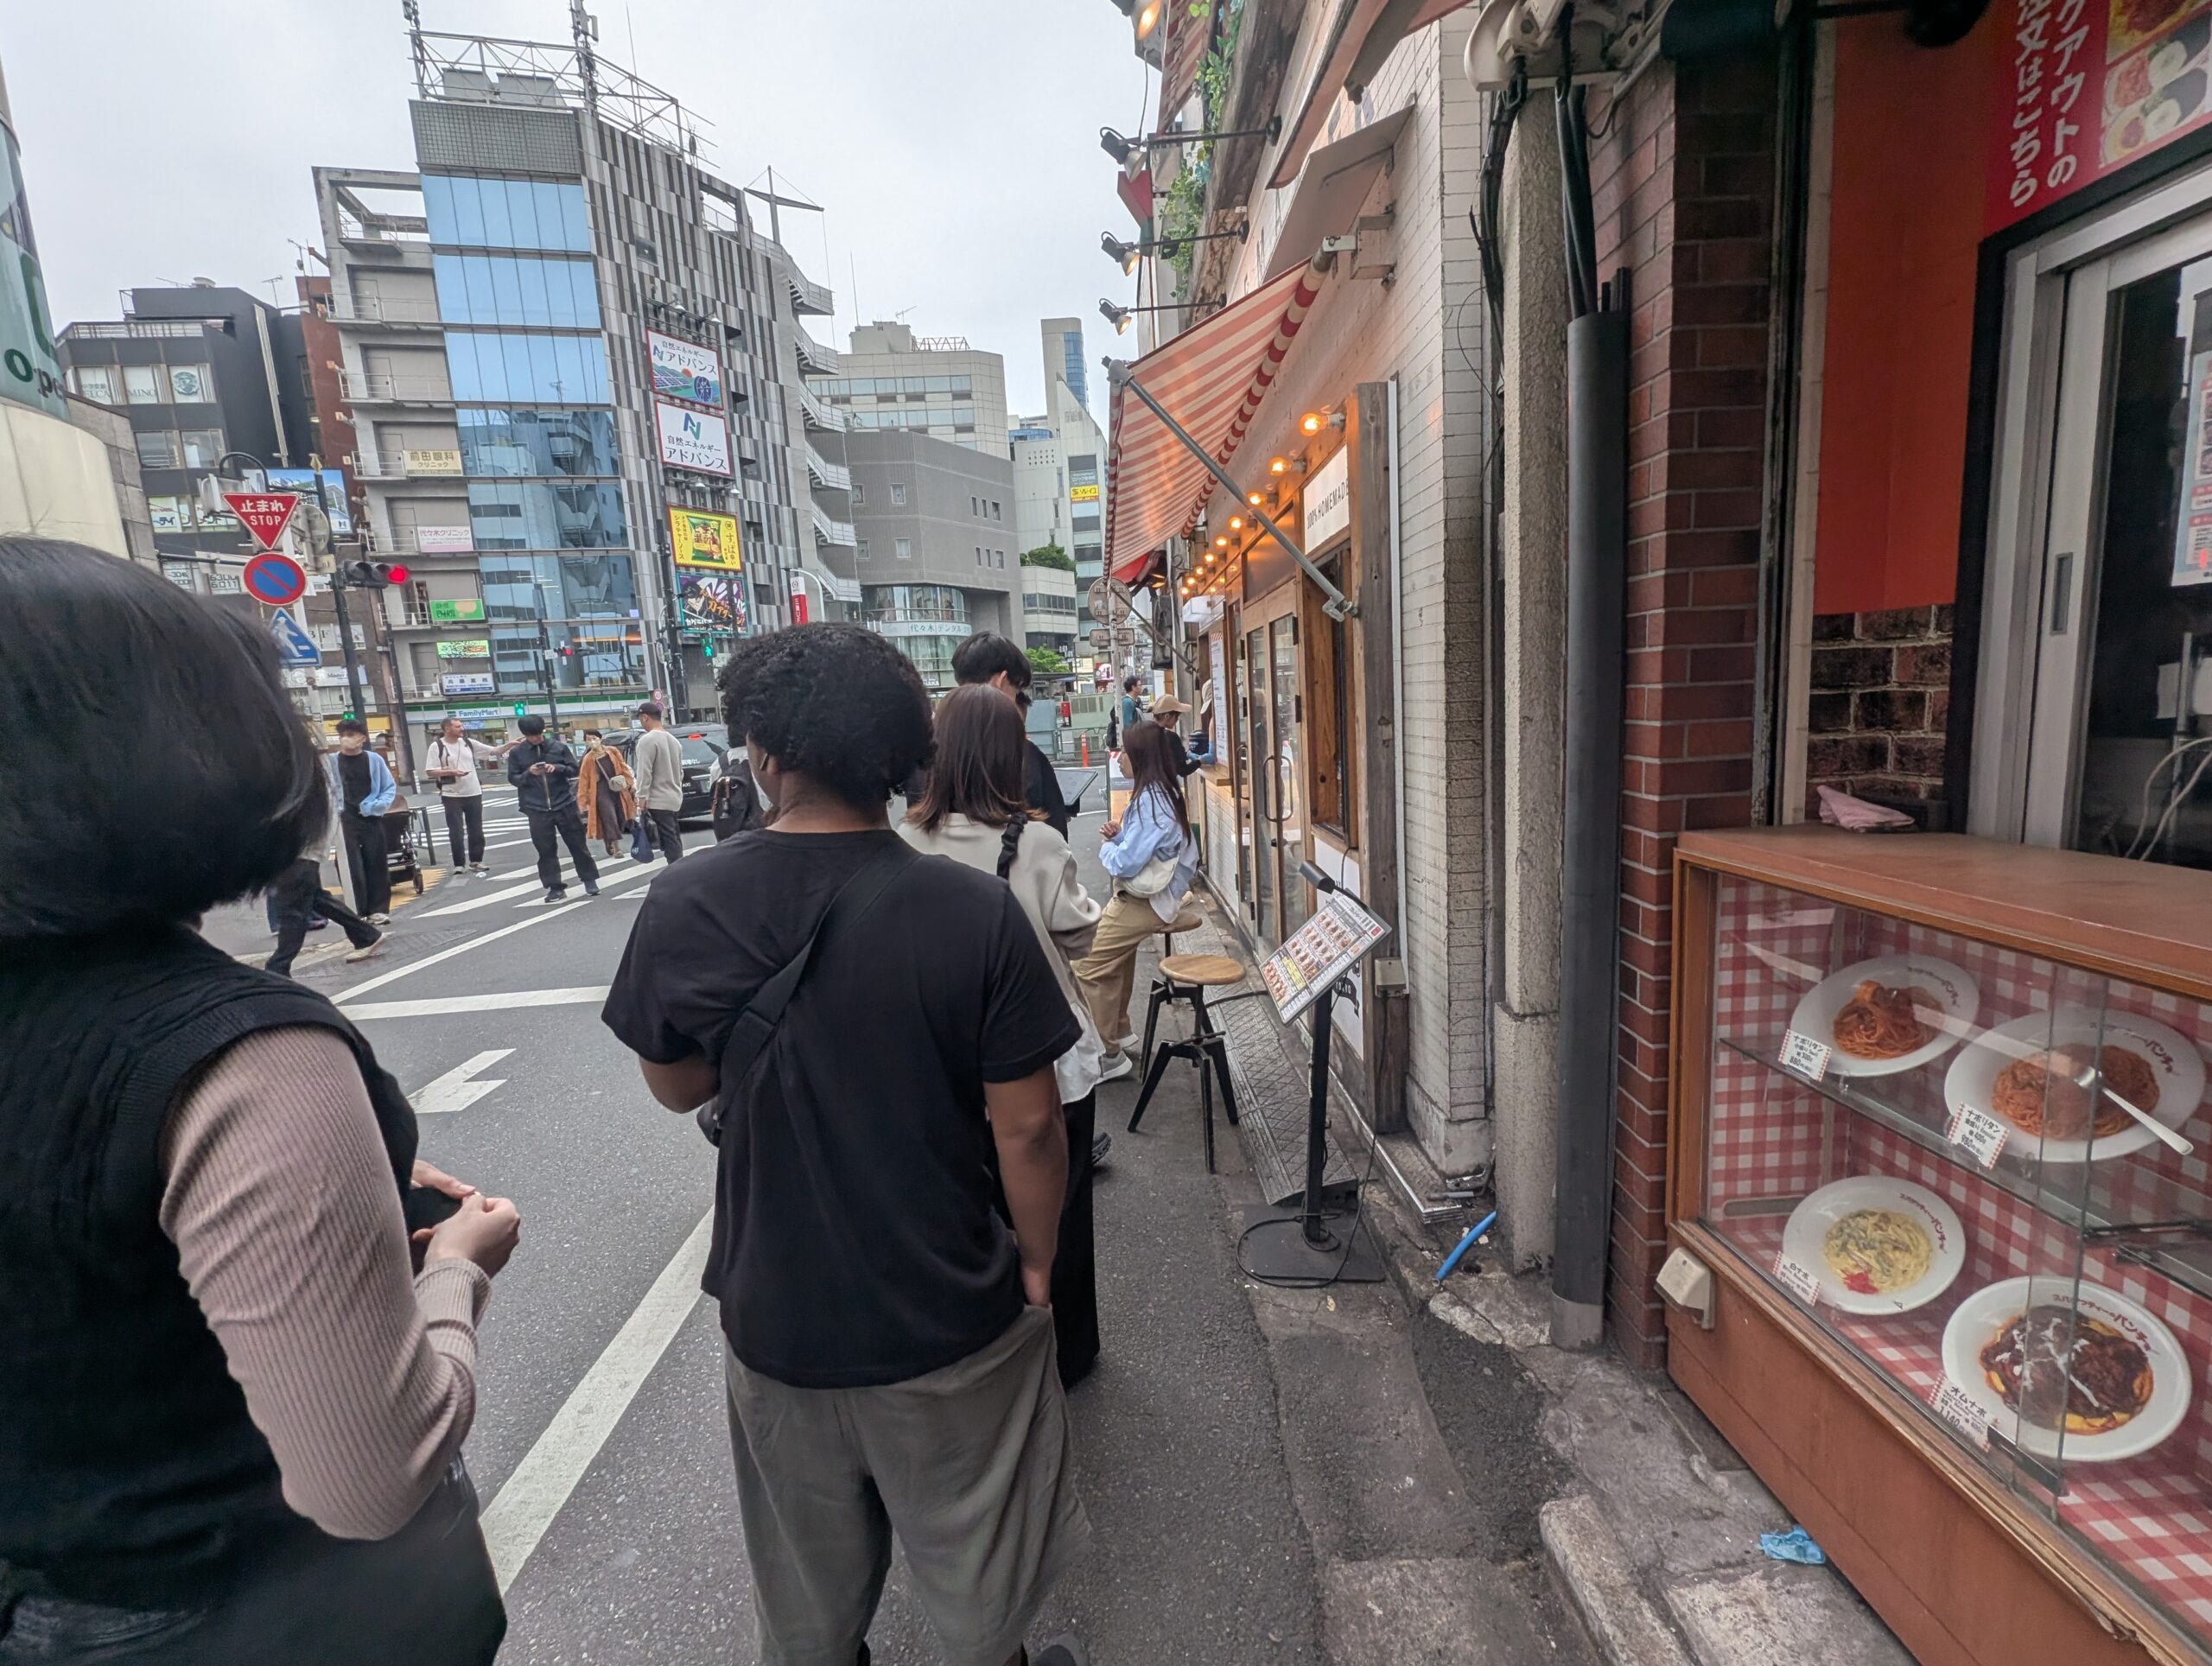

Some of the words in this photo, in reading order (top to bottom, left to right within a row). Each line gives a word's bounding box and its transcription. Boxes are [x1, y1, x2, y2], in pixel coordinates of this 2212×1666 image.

[662, 340, 705, 357] 自然エネルギー
[912, 337, 970, 352] MIYATA
[666, 351, 716, 375] アドバンス
[667, 436, 721, 452] 自然エネルギー
[410, 452, 454, 461] 前田眼科
[665, 446, 727, 470] アドバンス
[241, 499, 286, 512] 止まれ
[251, 515, 281, 525] STOP
[911, 624, 934, 633] 代々木
[458, 709, 499, 718] FamilyMart
[1794, 1035, 1823, 1052] ナポリタン
[1967, 1110, 2000, 1134] ナポリタン
[2052, 1294, 2161, 1356] スパッティーのパンチョ
[1951, 1386, 1987, 1418] オムナポ
